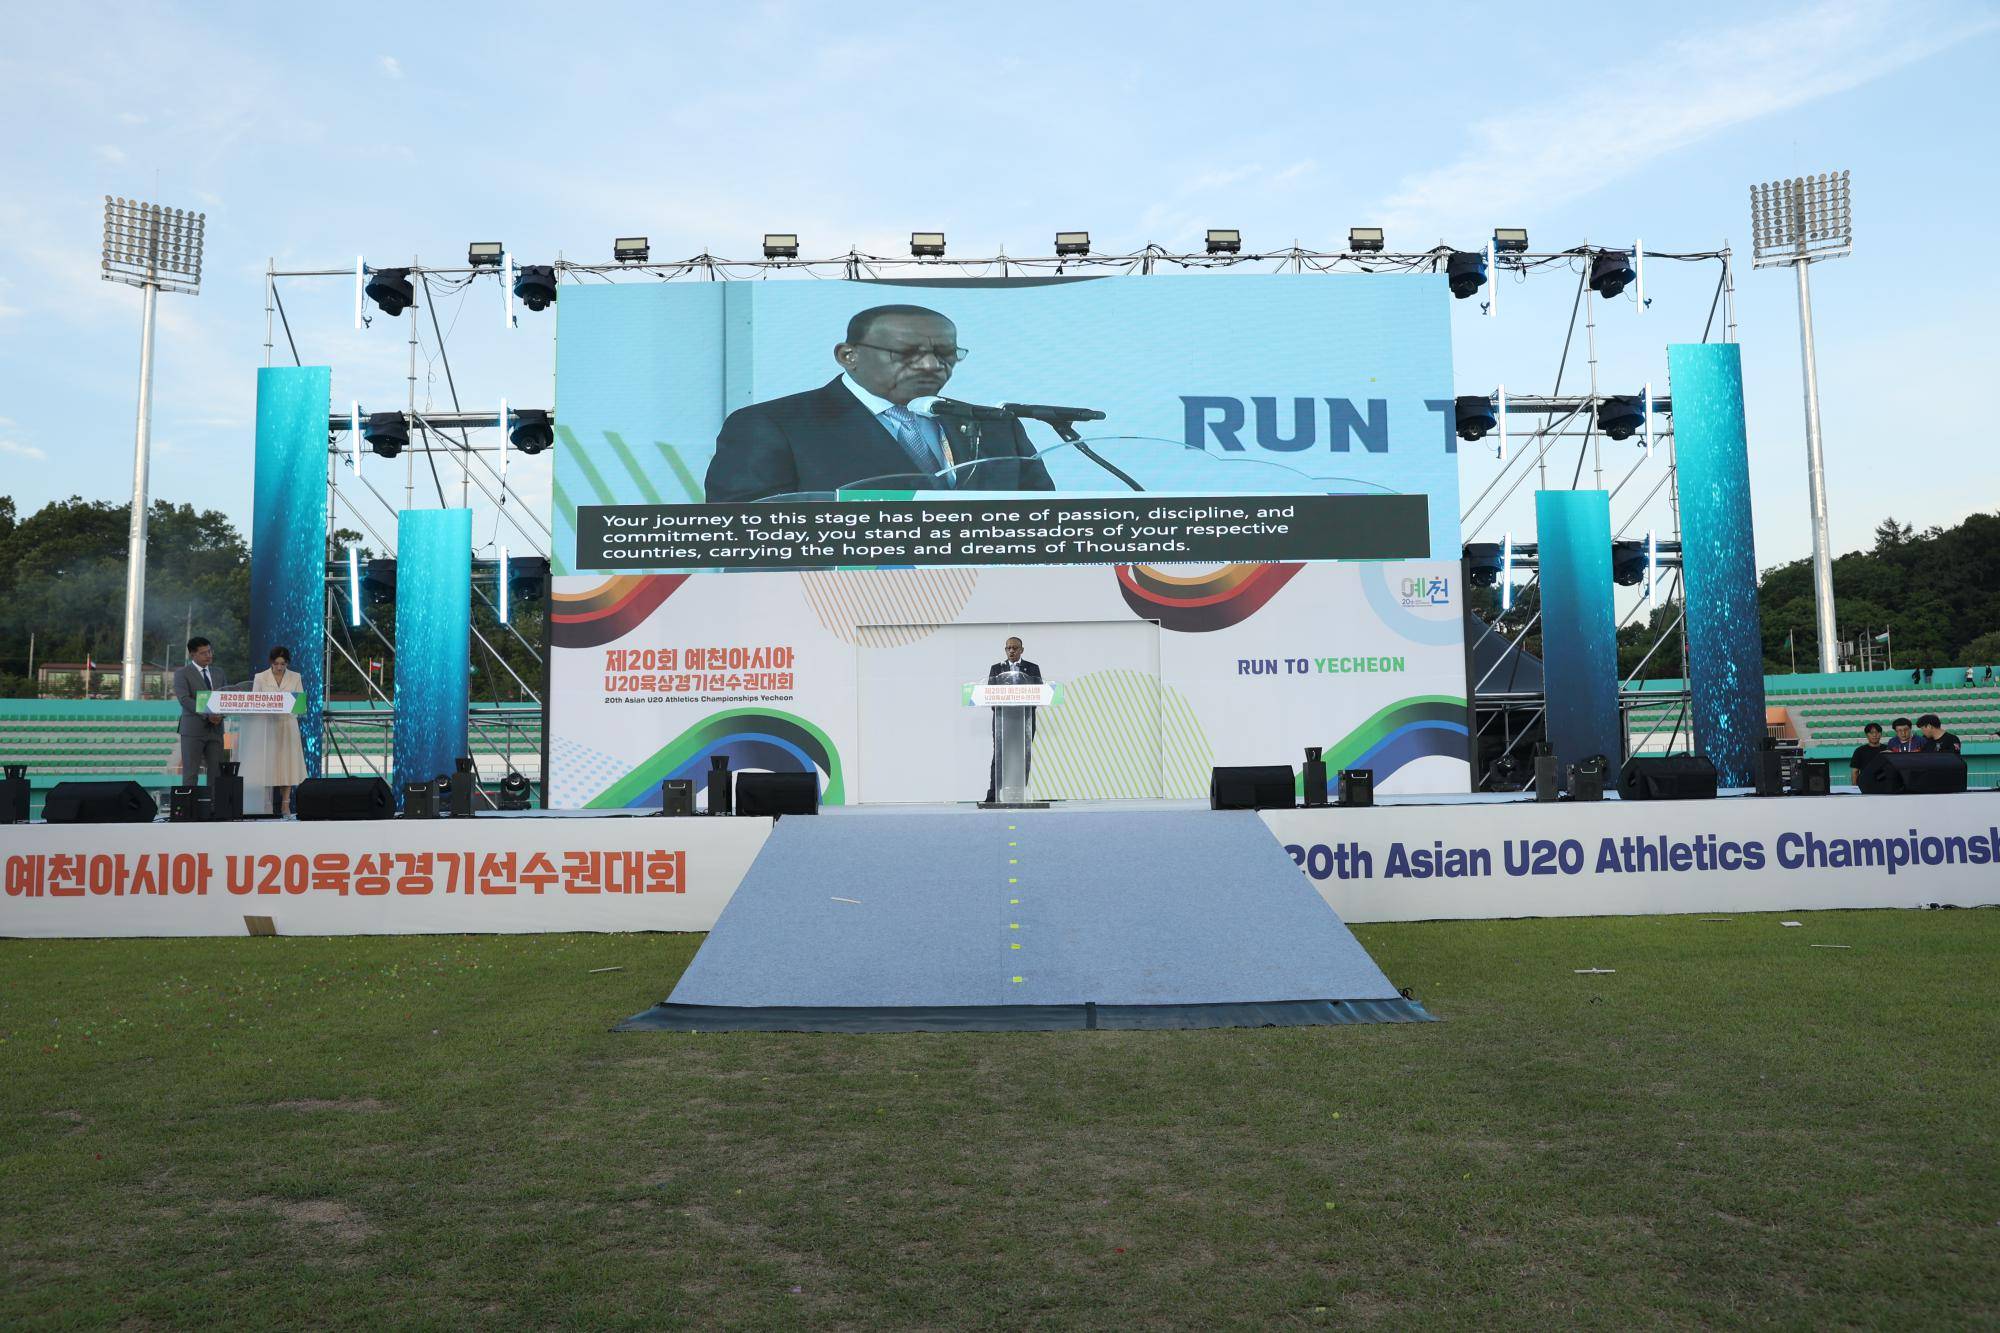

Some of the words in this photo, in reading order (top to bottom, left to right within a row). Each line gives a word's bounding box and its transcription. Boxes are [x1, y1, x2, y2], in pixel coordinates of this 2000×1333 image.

[1179, 396, 1388, 453] RUN
[603, 516, 648, 526] Your
[653, 514, 734, 529] journey
[740, 514, 762, 524] to
[770, 512, 806, 524] this
[815, 513, 870, 526] stage
[880, 511, 913, 522] has
[922, 510, 972, 522] been
[982, 513, 1020, 522] one
[1029, 509, 1050, 521] of
[1058, 508, 1139, 524] passion,
[1148, 507, 1248, 522] discipline,
[1257, 506, 1294, 518] and
[603, 530, 738, 543] commitment.
[746, 529, 810, 543] Today,
[818, 531, 856, 542] you
[865, 527, 920, 539] stand
[930, 530, 951, 538] as
[960, 525, 1094, 538] ambassadors
[1103, 524, 1124, 536] of
[1131, 526, 1178, 538] your
[1186, 522, 1288, 538] respective
[603, 546, 701, 559] countries,
[710, 545, 792, 560] carrying
[801, 544, 834, 556] the
[843, 544, 905, 558] hopes
[914, 543, 951, 554] and
[961, 542, 1036, 554] dreams
[1046, 541, 1066, 553] of
[1073, 539, 1190, 552] Thousands.
[606, 650, 677, 671] 제20회
[686, 646, 794, 671] 예천아시아
[1238, 658, 1278, 674] RUN
[1284, 657, 1309, 674] TO
[1314, 656, 1405, 673] YECHEON
[606, 673, 794, 692] U20육상경기선수권대회
[701, 695, 758, 703] Championships
[761, 694, 793, 702] Yecheon
[1386, 842, 1491, 878] Asian
[1505, 840, 1584, 876] U20
[1596, 834, 1765, 873] Athletics
[6, 854, 212, 896] 예천아시아
[227, 850, 686, 896] U20육상경기선수권대회
